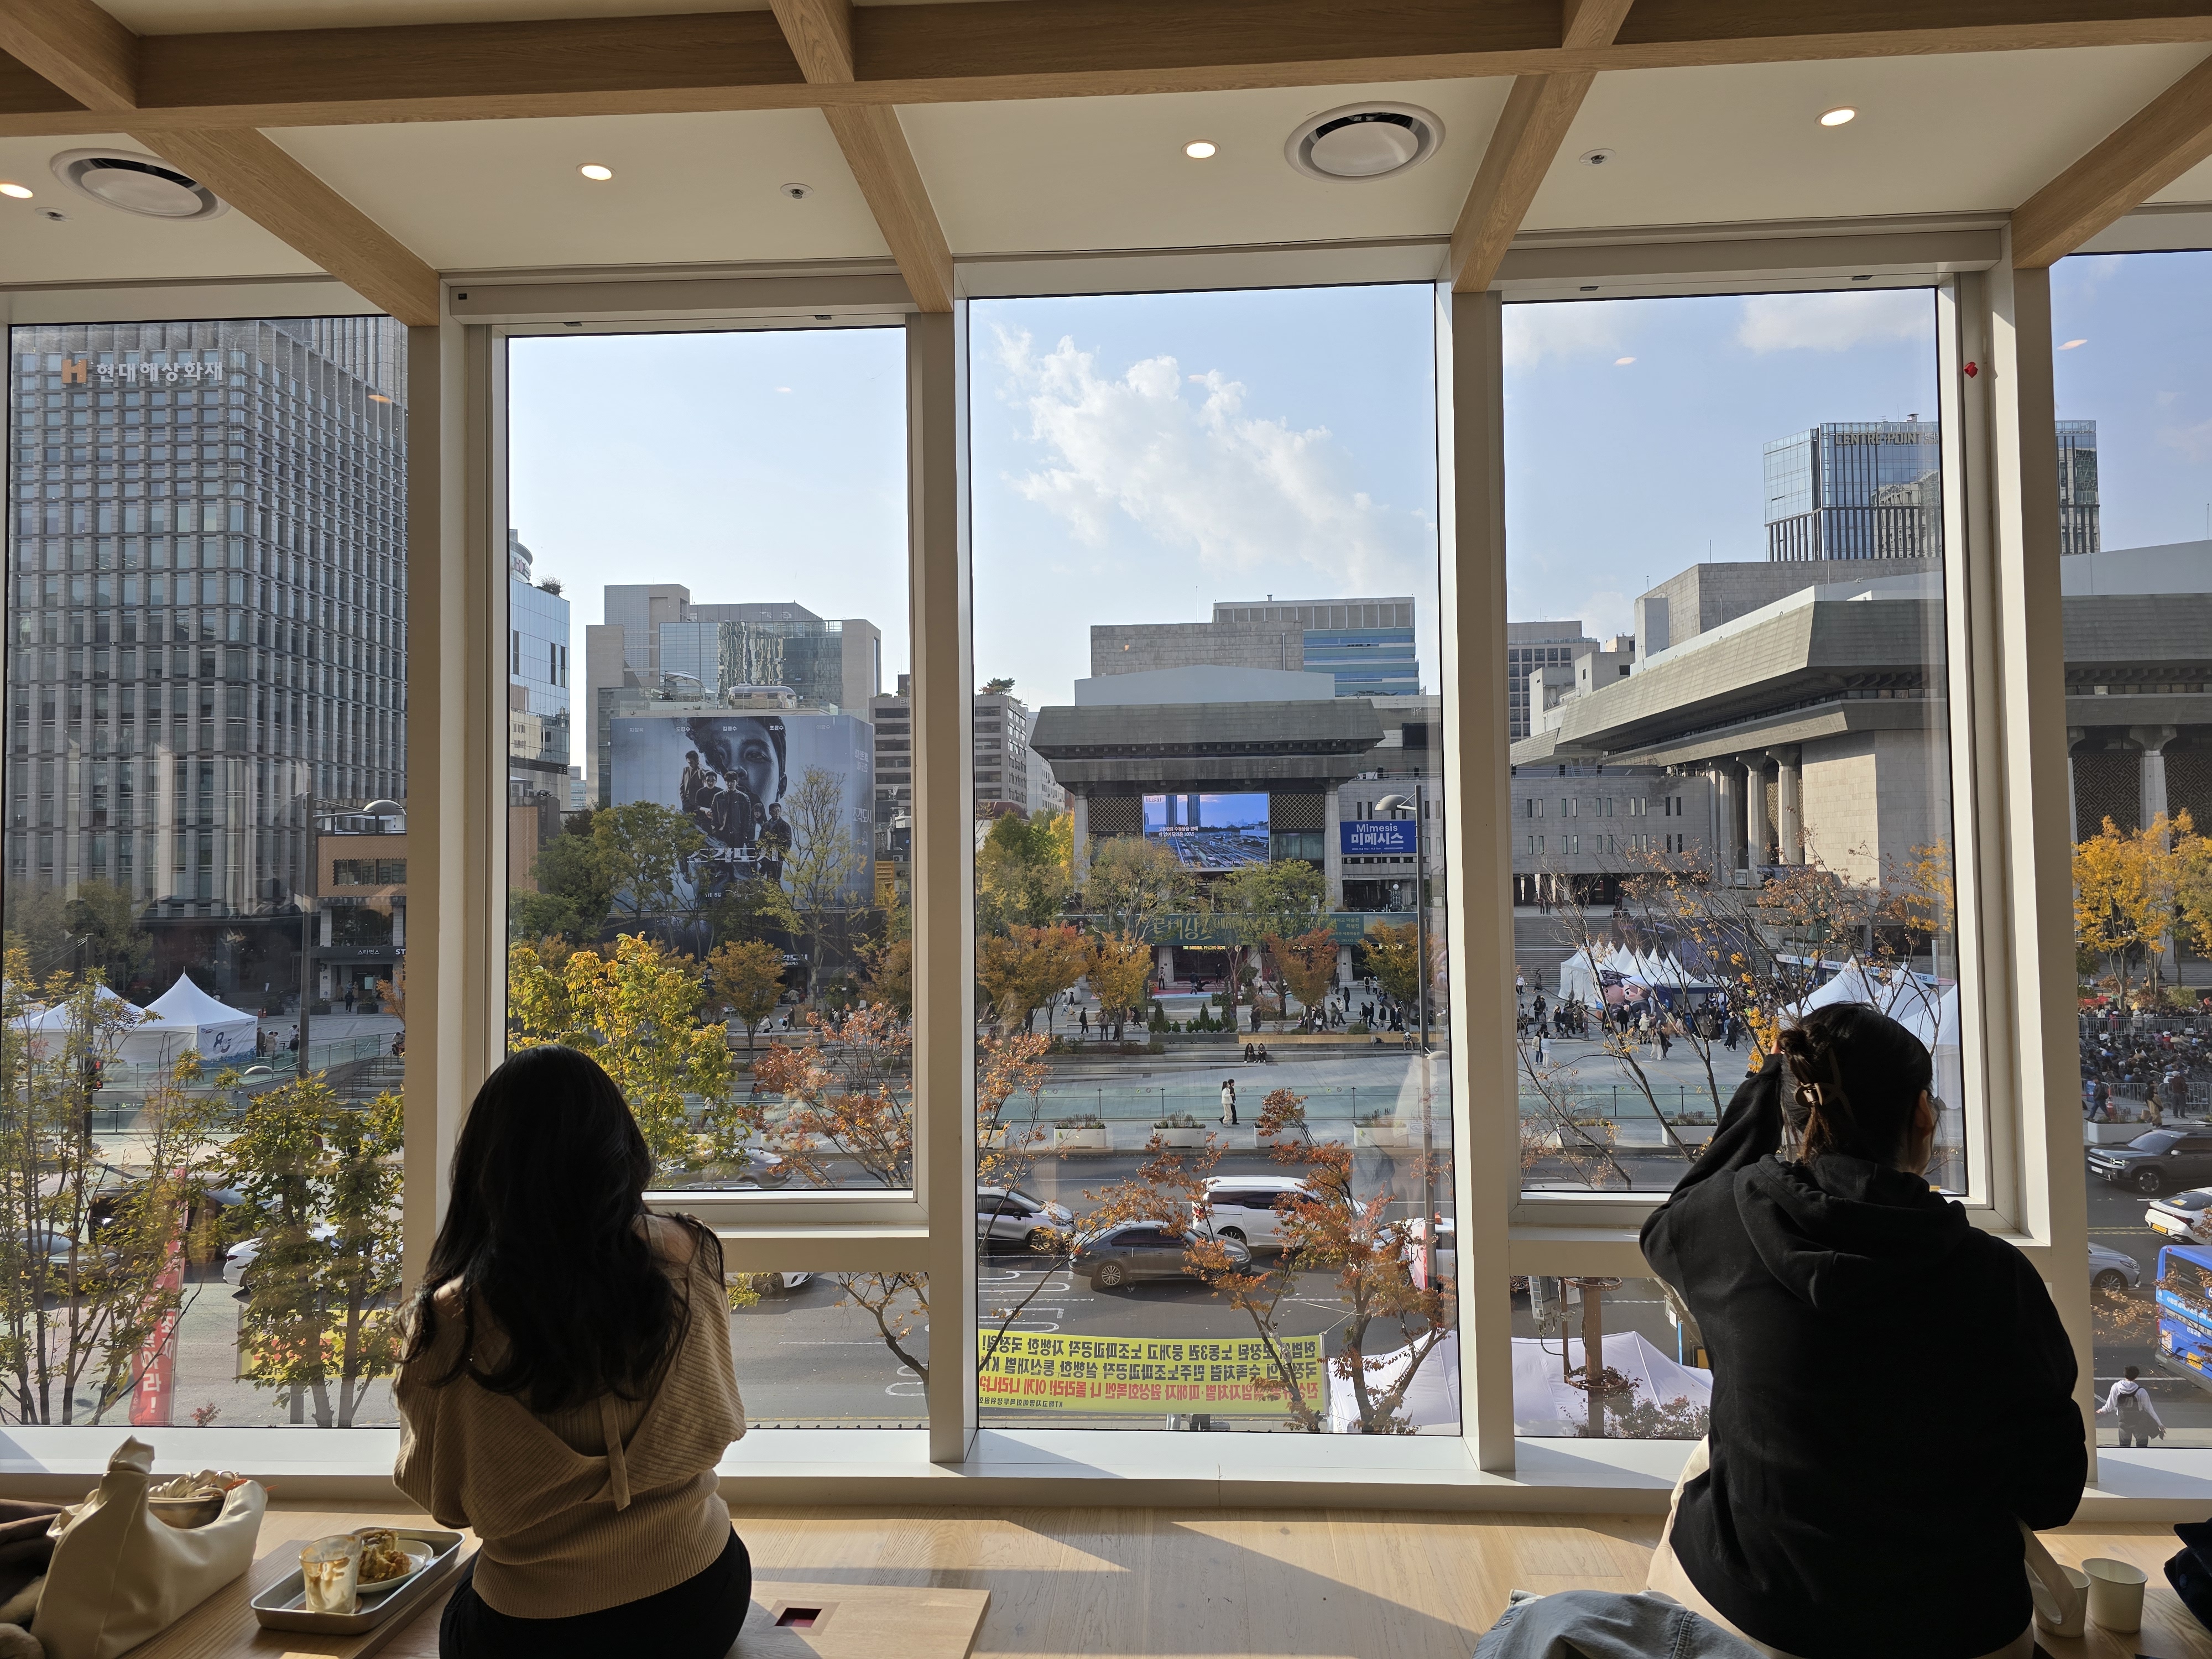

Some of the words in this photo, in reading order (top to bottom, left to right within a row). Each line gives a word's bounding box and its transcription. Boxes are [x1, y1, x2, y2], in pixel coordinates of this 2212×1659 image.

[96, 361, 223, 383] 현대해상화재
[1356, 823, 1398, 832] Mimesis
[1351, 832, 1404, 846] 미메시스
